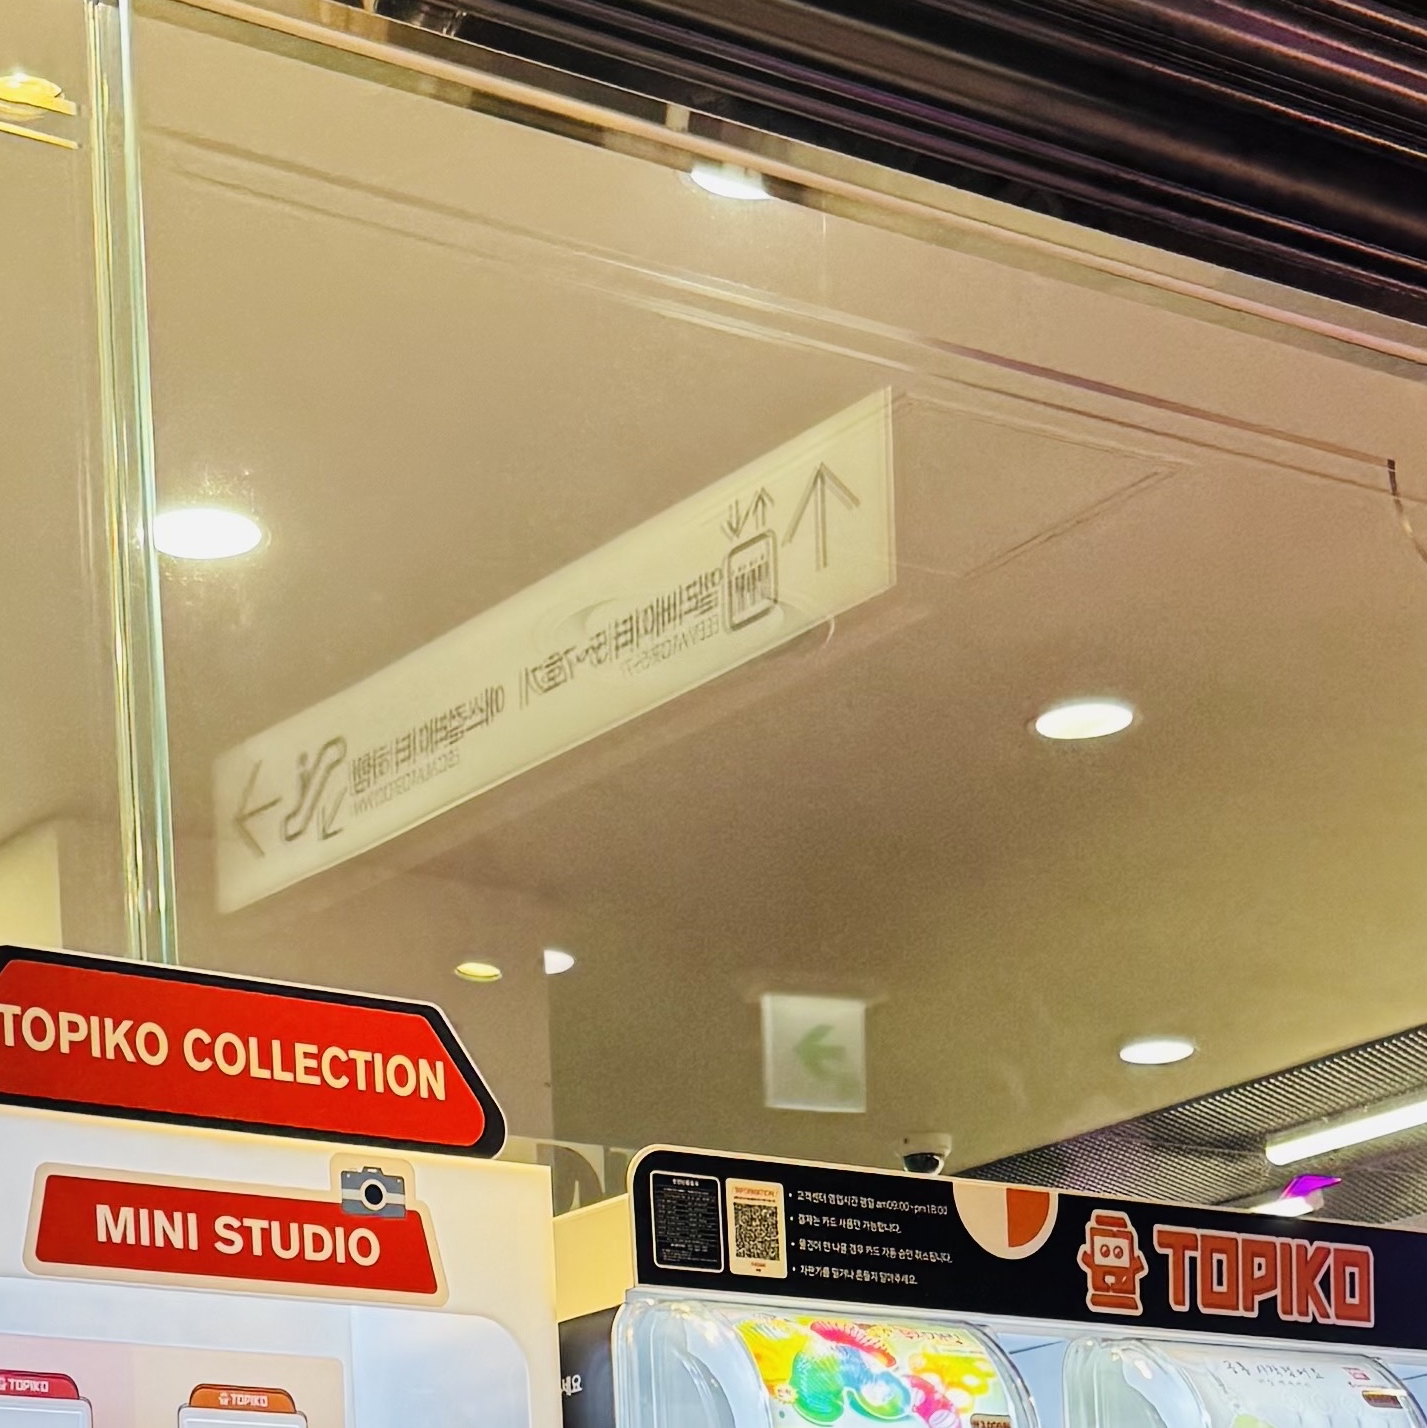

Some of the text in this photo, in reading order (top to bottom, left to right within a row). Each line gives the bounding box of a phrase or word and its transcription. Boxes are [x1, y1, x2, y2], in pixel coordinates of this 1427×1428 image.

[183, 1028, 448, 1101] COLLECTION
[95, 1202, 382, 1267] MINI STUDIO
[1153, 1222, 1375, 1329] TOPIKO
[7, 1377, 50, 1394] TOPIKO
[230, 1393, 269, 1408] TOPIKO
